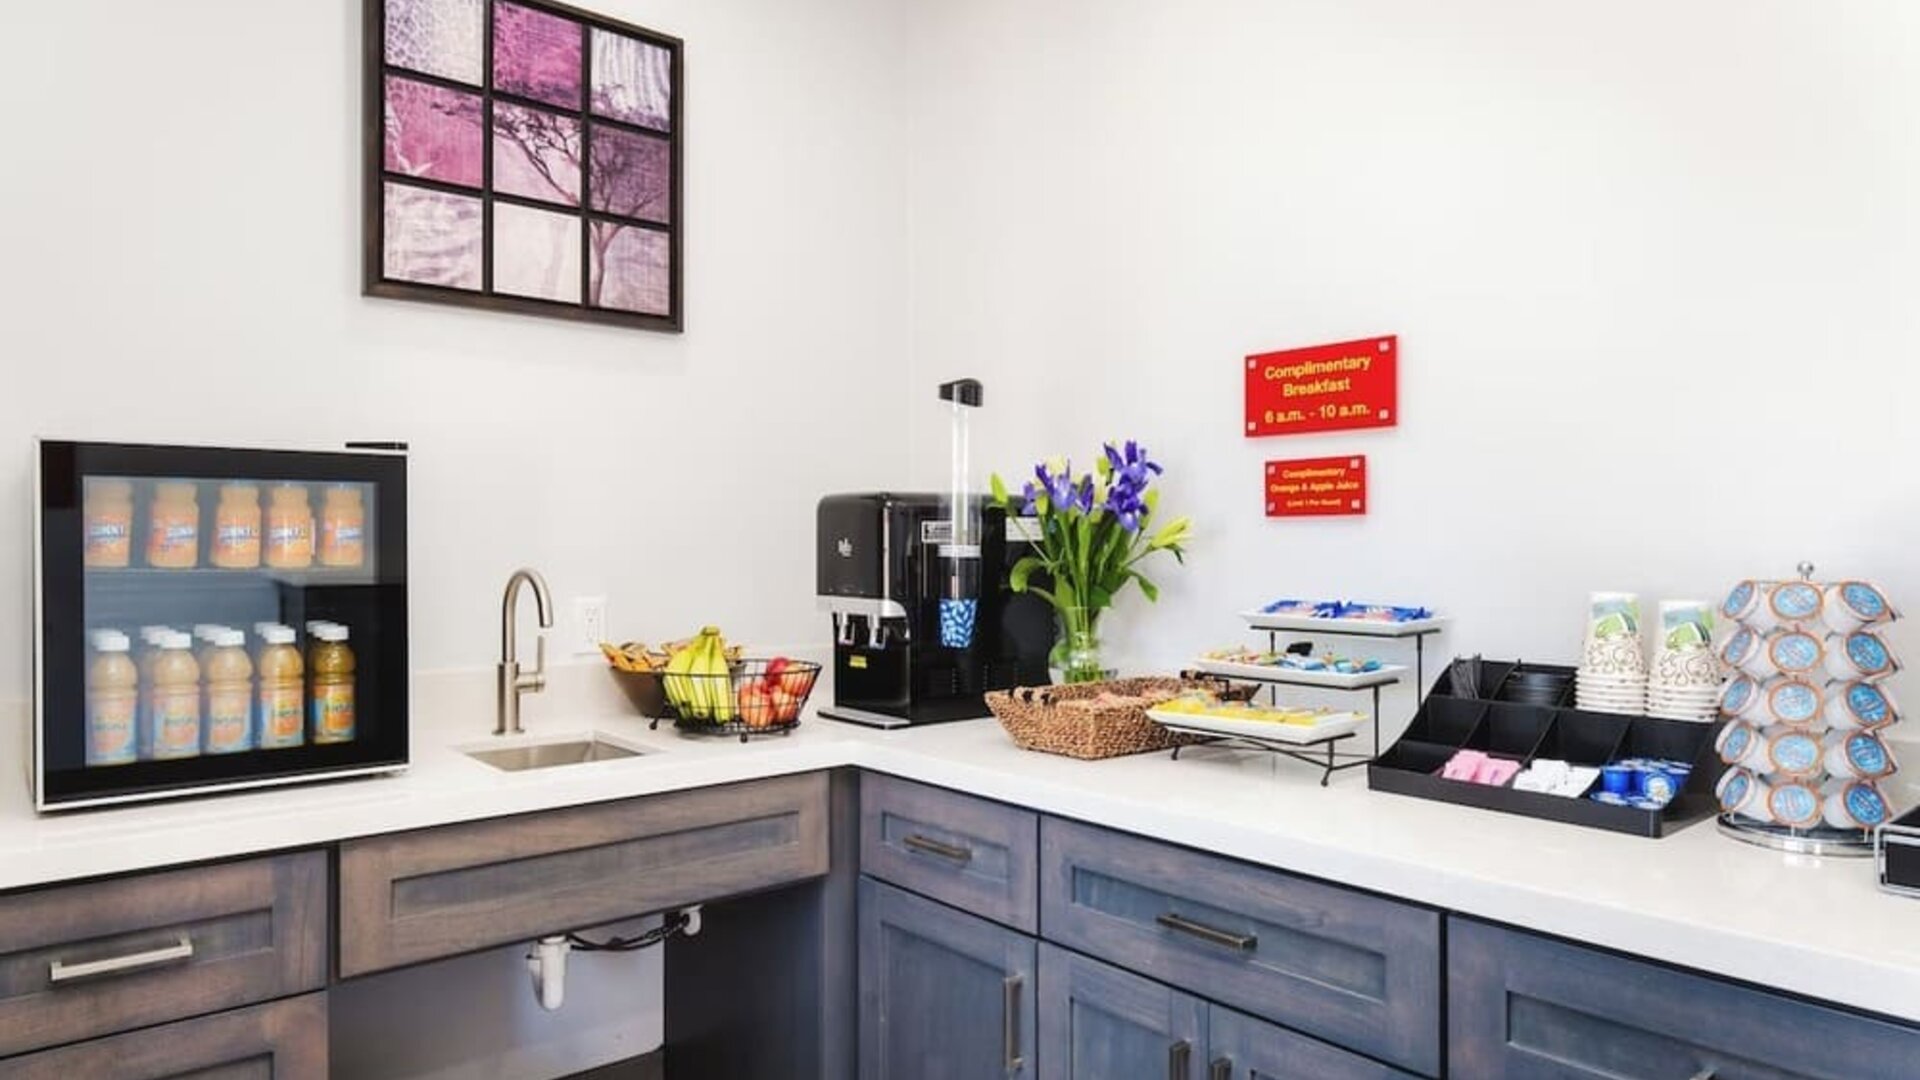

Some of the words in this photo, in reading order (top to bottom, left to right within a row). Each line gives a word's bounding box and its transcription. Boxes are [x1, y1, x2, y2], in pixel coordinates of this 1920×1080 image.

[1265, 356, 1371, 379] Complimentary
[1283, 377, 1351, 397] Breakfast
[1264, 410, 1274, 423] 6
[1276, 409, 1306, 422] a.m.
[1319, 404, 1336, 419] 10
[1339, 403, 1371, 416] a.m.
[1282, 468, 1346, 479] Complimentary
[1270, 484, 1300, 494] Orange
[1310, 482, 1335, 492] Apple
